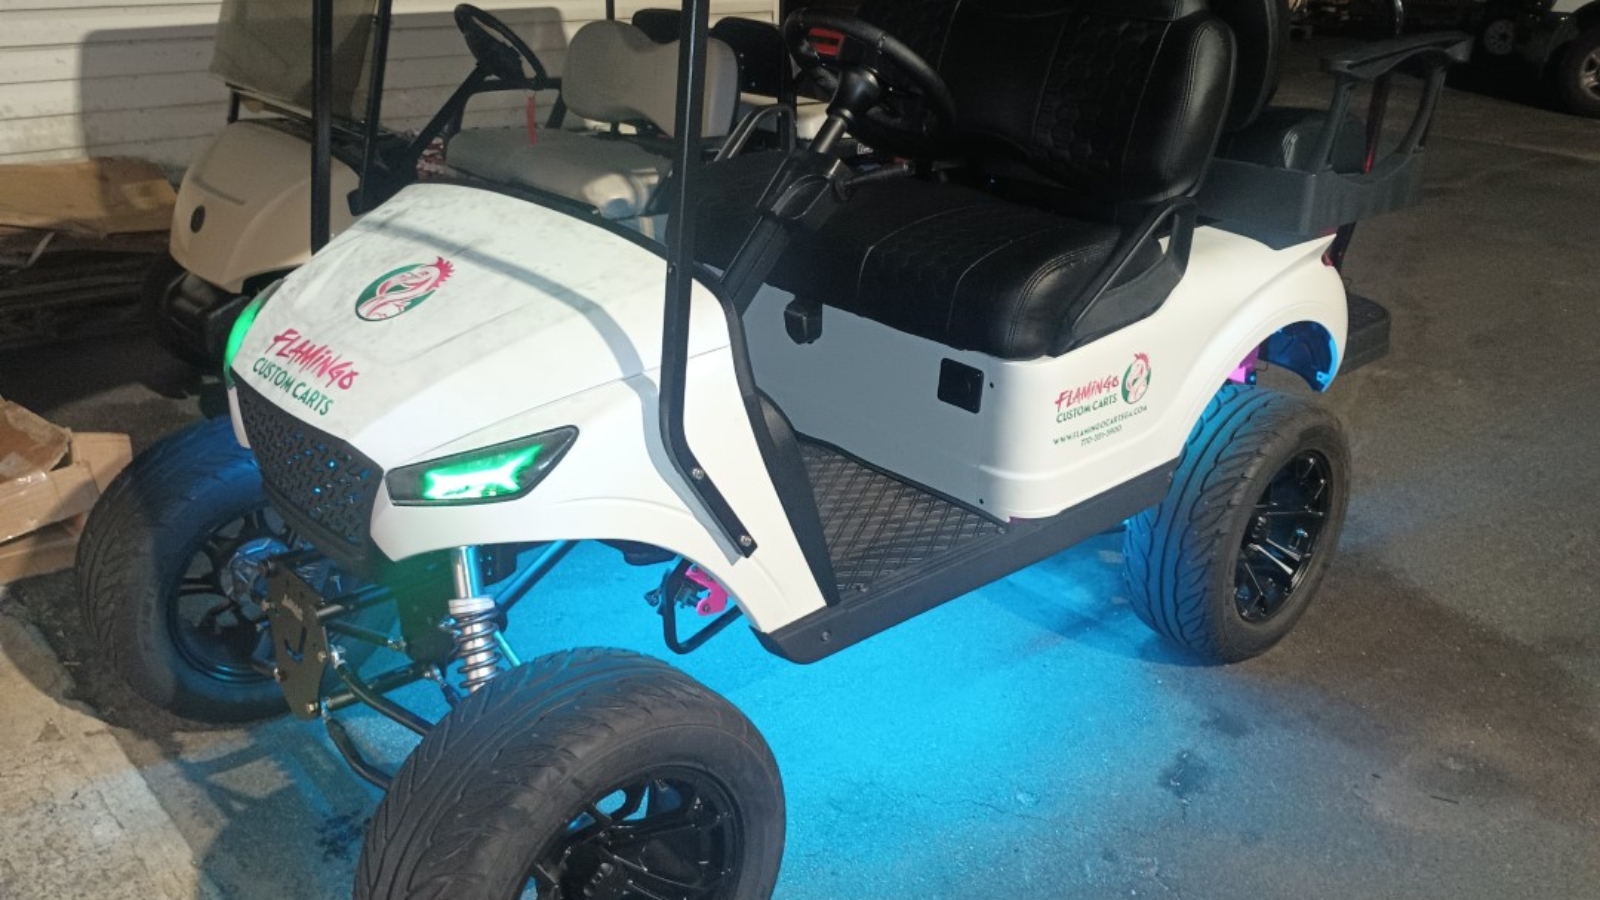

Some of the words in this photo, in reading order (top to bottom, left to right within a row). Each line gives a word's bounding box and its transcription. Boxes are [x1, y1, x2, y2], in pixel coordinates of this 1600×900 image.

[253, 357, 293, 393] CUSTOM
[292, 382, 333, 416] CARTS
[1056, 404, 1090, 423] CUSTOM
[1092, 394, 1117, 411] CARTS
